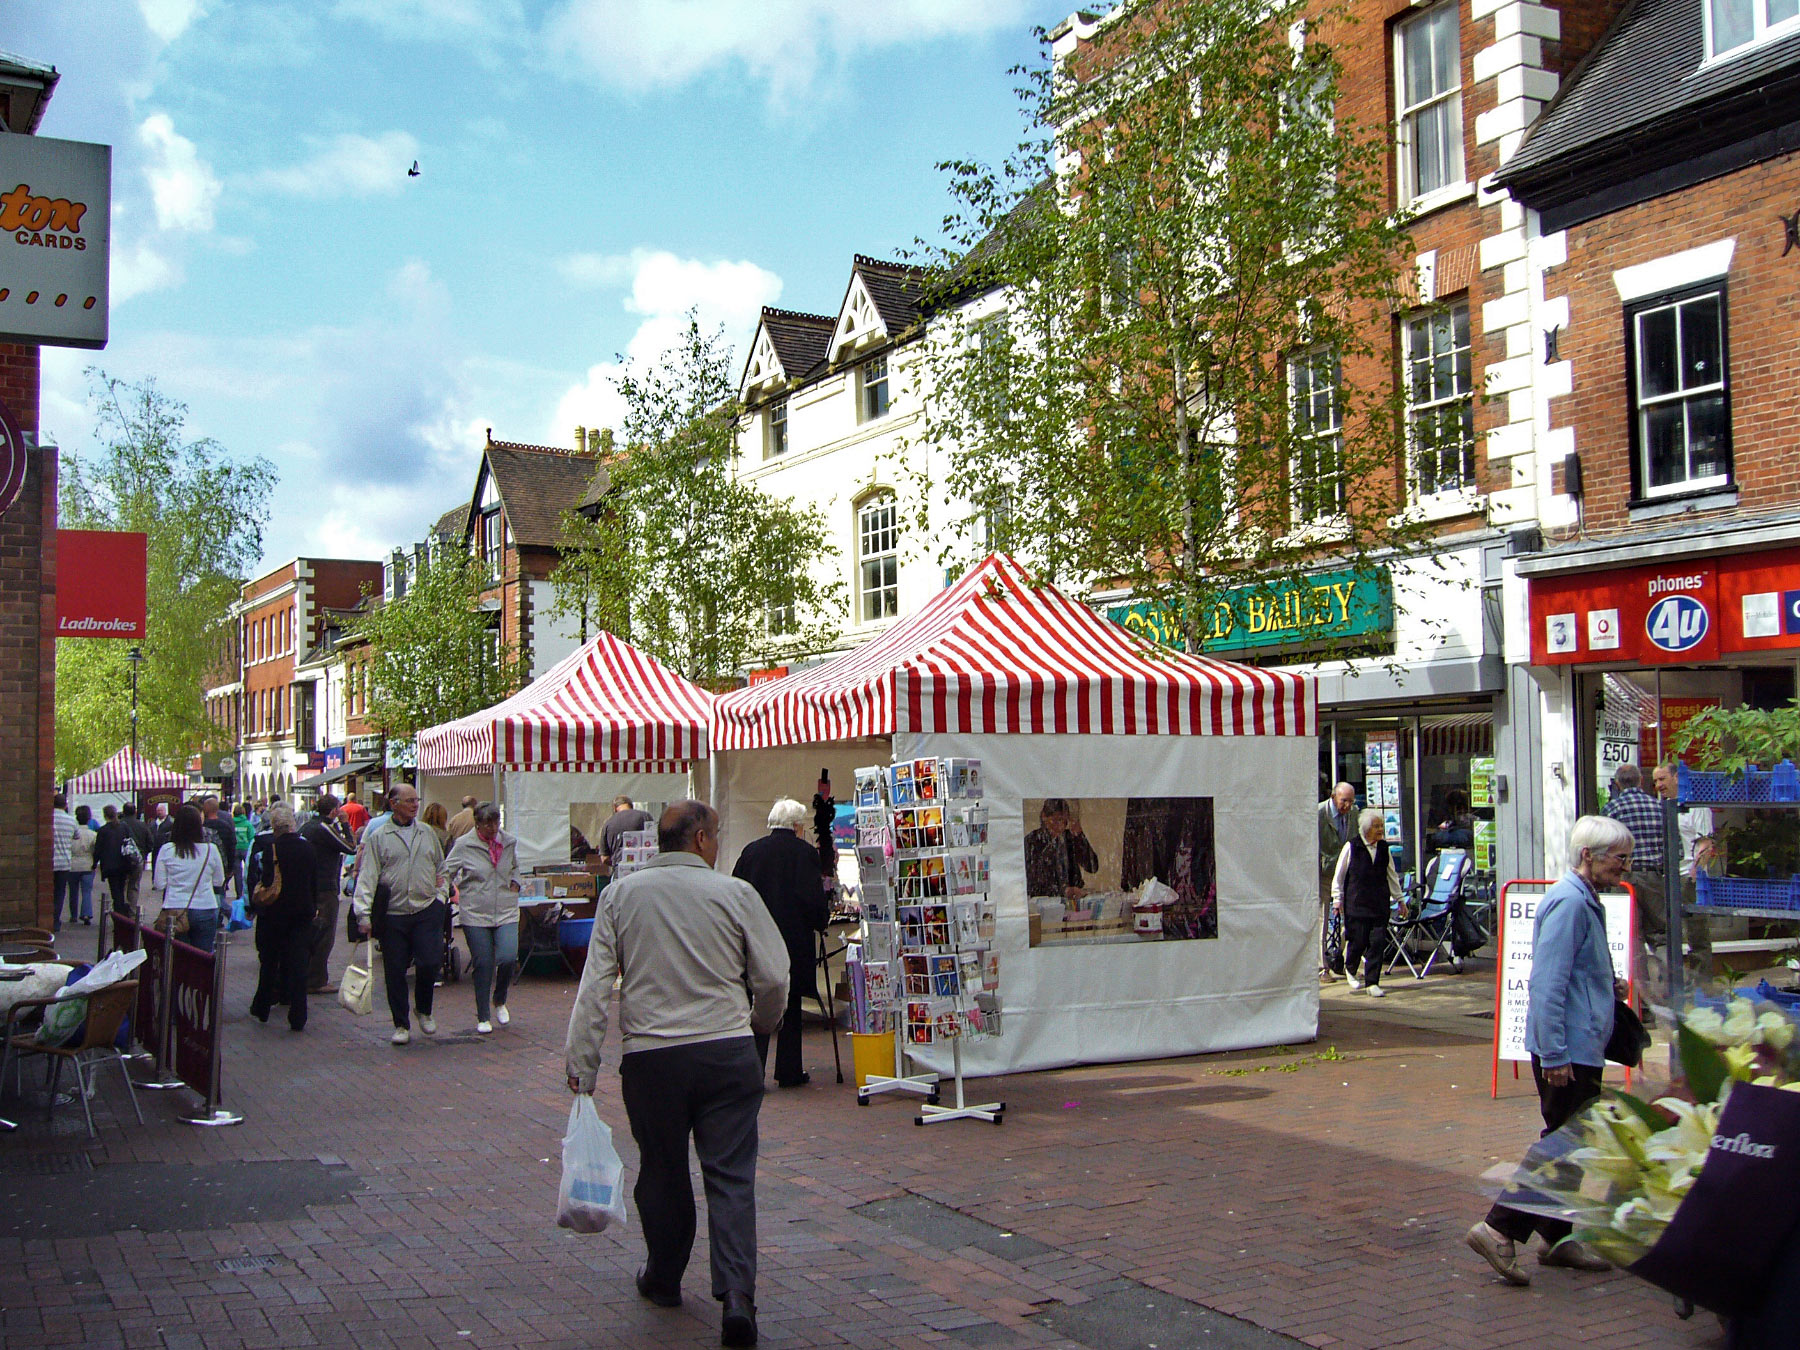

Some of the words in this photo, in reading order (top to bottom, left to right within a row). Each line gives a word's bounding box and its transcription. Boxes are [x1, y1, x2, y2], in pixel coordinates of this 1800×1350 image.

[0, 184, 87, 233] ton
[15, 231, 87, 251] CARDS
[1648, 574, 1703, 597] phones
[1248, 581, 1355, 634] BAILEY
[60, 616, 137, 631] Ladbrokes
[1552, 621, 1567, 646] 3
[1662, 703, 1701, 718] iggest
[1603, 743, 1630, 763] £50
